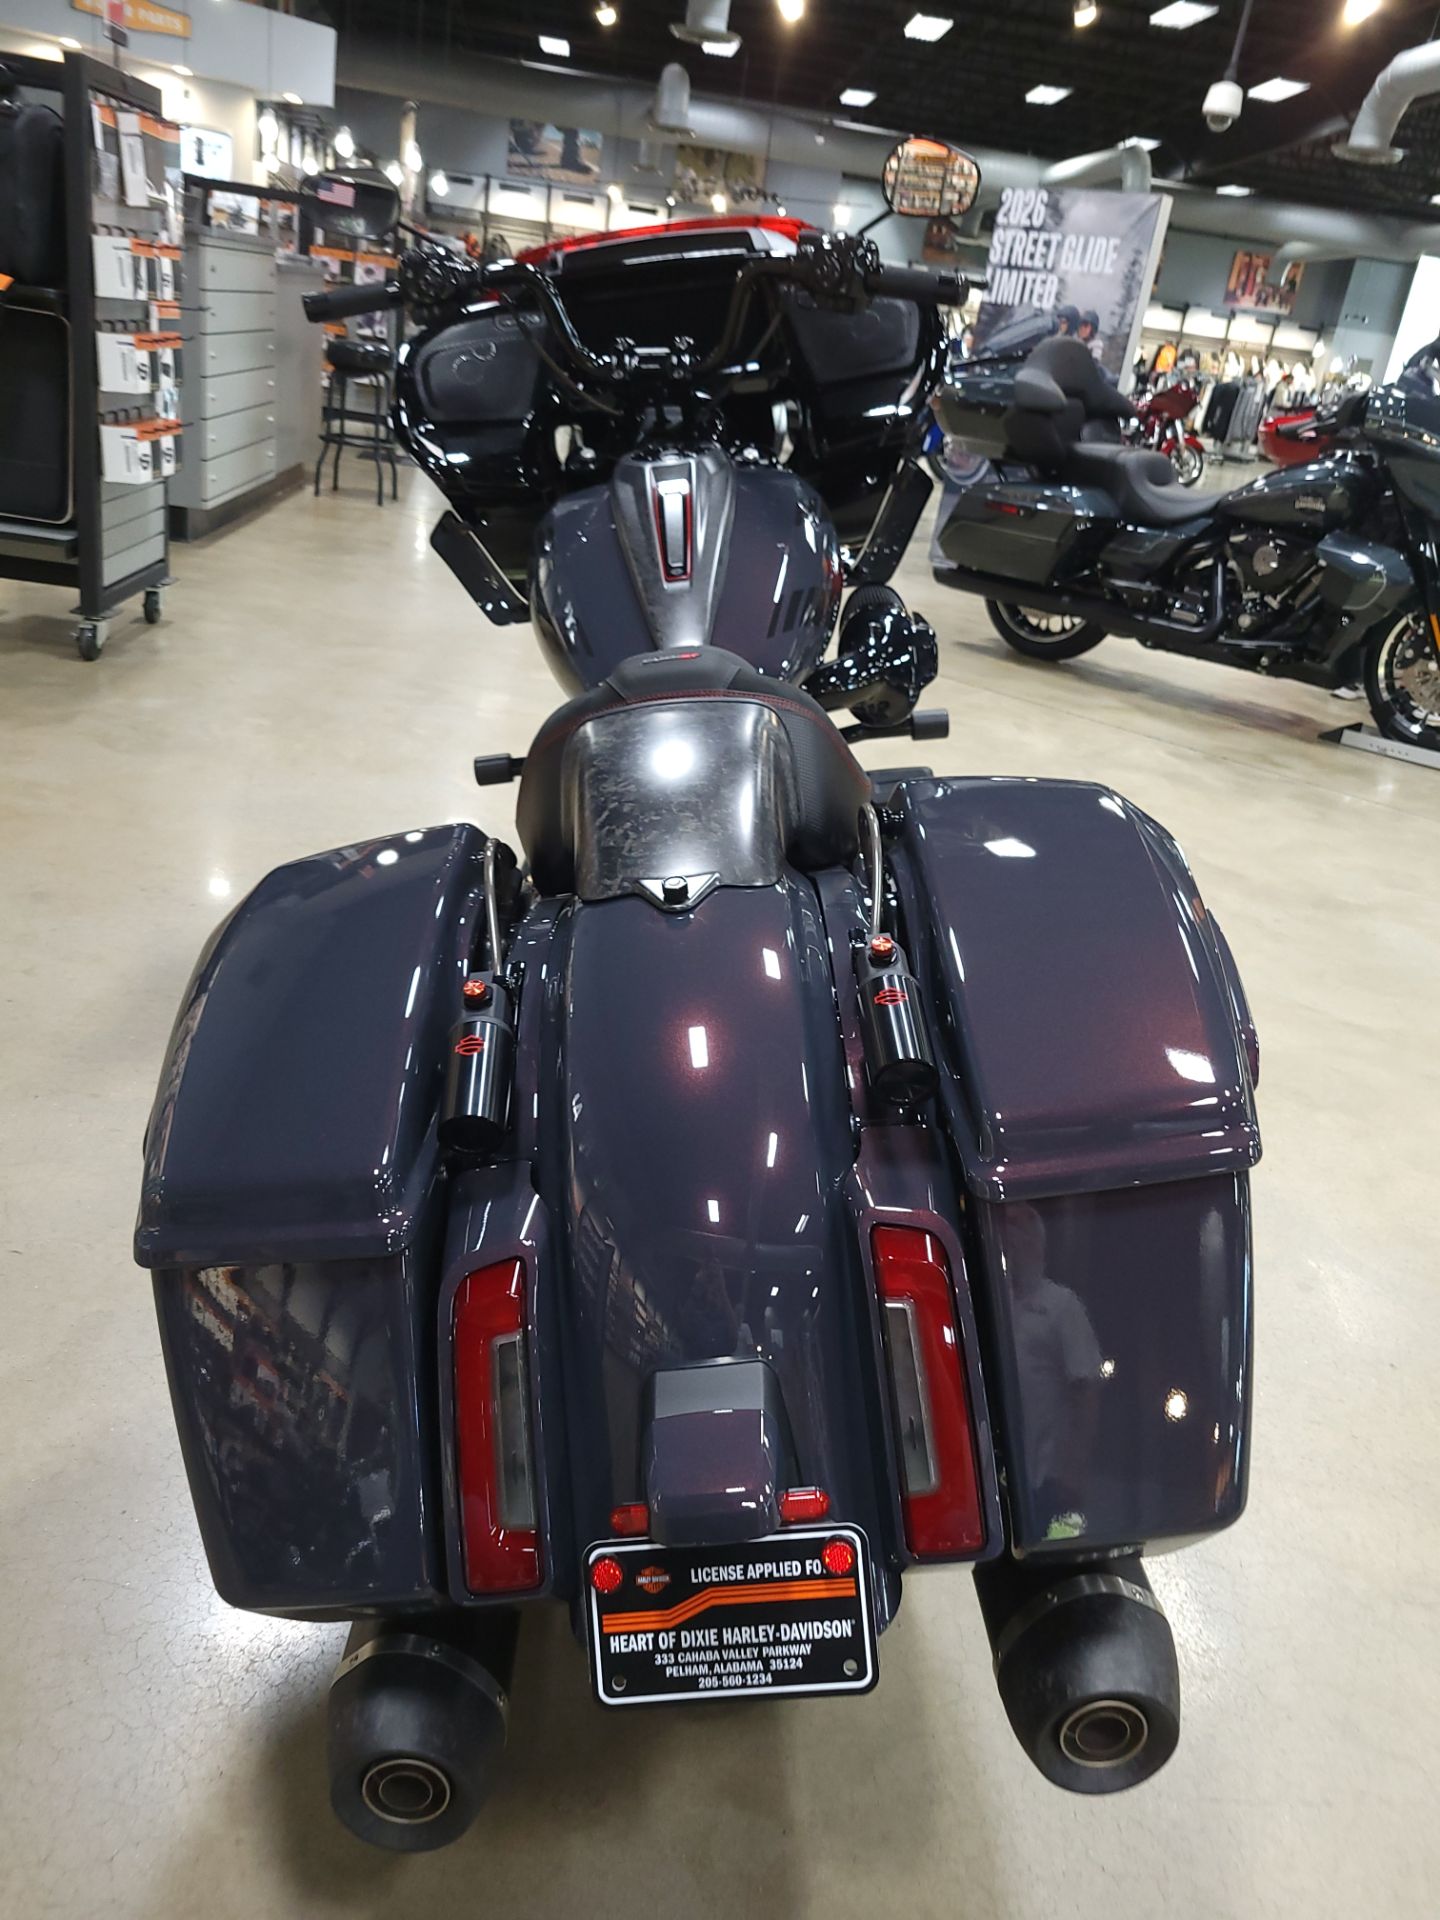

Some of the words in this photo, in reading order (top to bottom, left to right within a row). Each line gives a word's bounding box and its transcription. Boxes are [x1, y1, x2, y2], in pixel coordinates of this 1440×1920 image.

[997, 187, 1048, 228] 2026
[989, 229, 1062, 269] STREET
[1060, 234, 1120, 274] GLIDE
[690, 1565, 745, 1583] LICENSE
[747, 1560, 802, 1580] APPLIED
[805, 1558, 827, 1575] FO
[610, 1632, 655, 1654] HEART
[658, 1631, 676, 1650] OF
[680, 1628, 719, 1648] DIXIE
[722, 1619, 852, 1645] HARLEY-DAVIDSON
[654, 1653, 675, 1665] 333
[677, 1649, 720, 1663] CAHABA
[721, 1647, 759, 1660] VALLEY
[762, 1643, 812, 1658] PARKWAY
[665, 1664, 712, 1678] PELHAM,
[713, 1660, 764, 1674] ALABAMA
[769, 1656, 803, 1671] 35124
